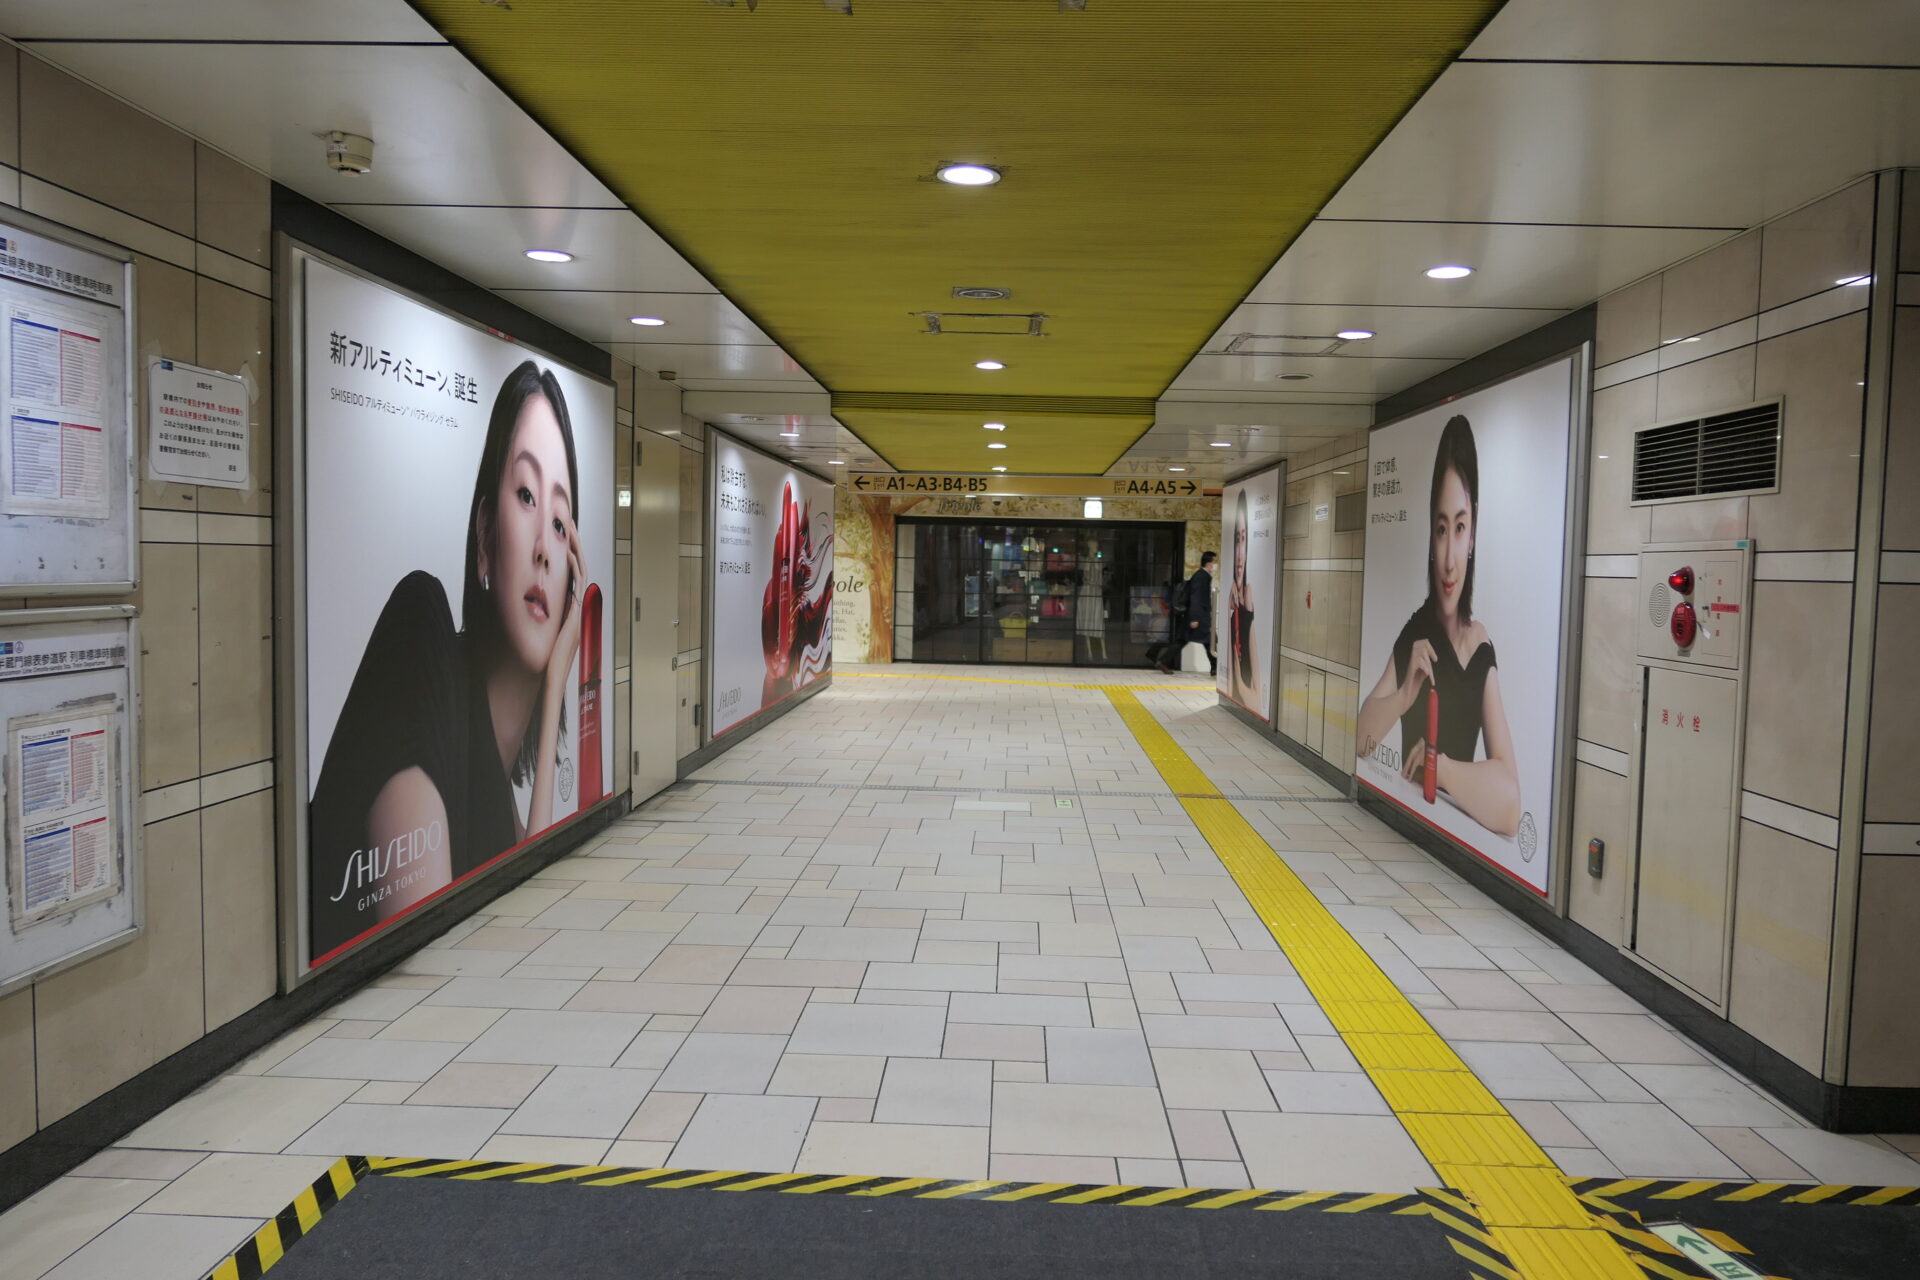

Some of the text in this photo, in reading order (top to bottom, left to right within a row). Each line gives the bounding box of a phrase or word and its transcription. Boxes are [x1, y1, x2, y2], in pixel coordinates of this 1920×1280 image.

[330, 331, 478, 405] 新アルティミューン、誕生
[330, 387, 364, 407] SHISEIDO
[1360, 734, 1401, 772] SHISEIDO
[330, 820, 441, 902] SHISEIDO
[358, 866, 427, 911] GINZA TOKYO
